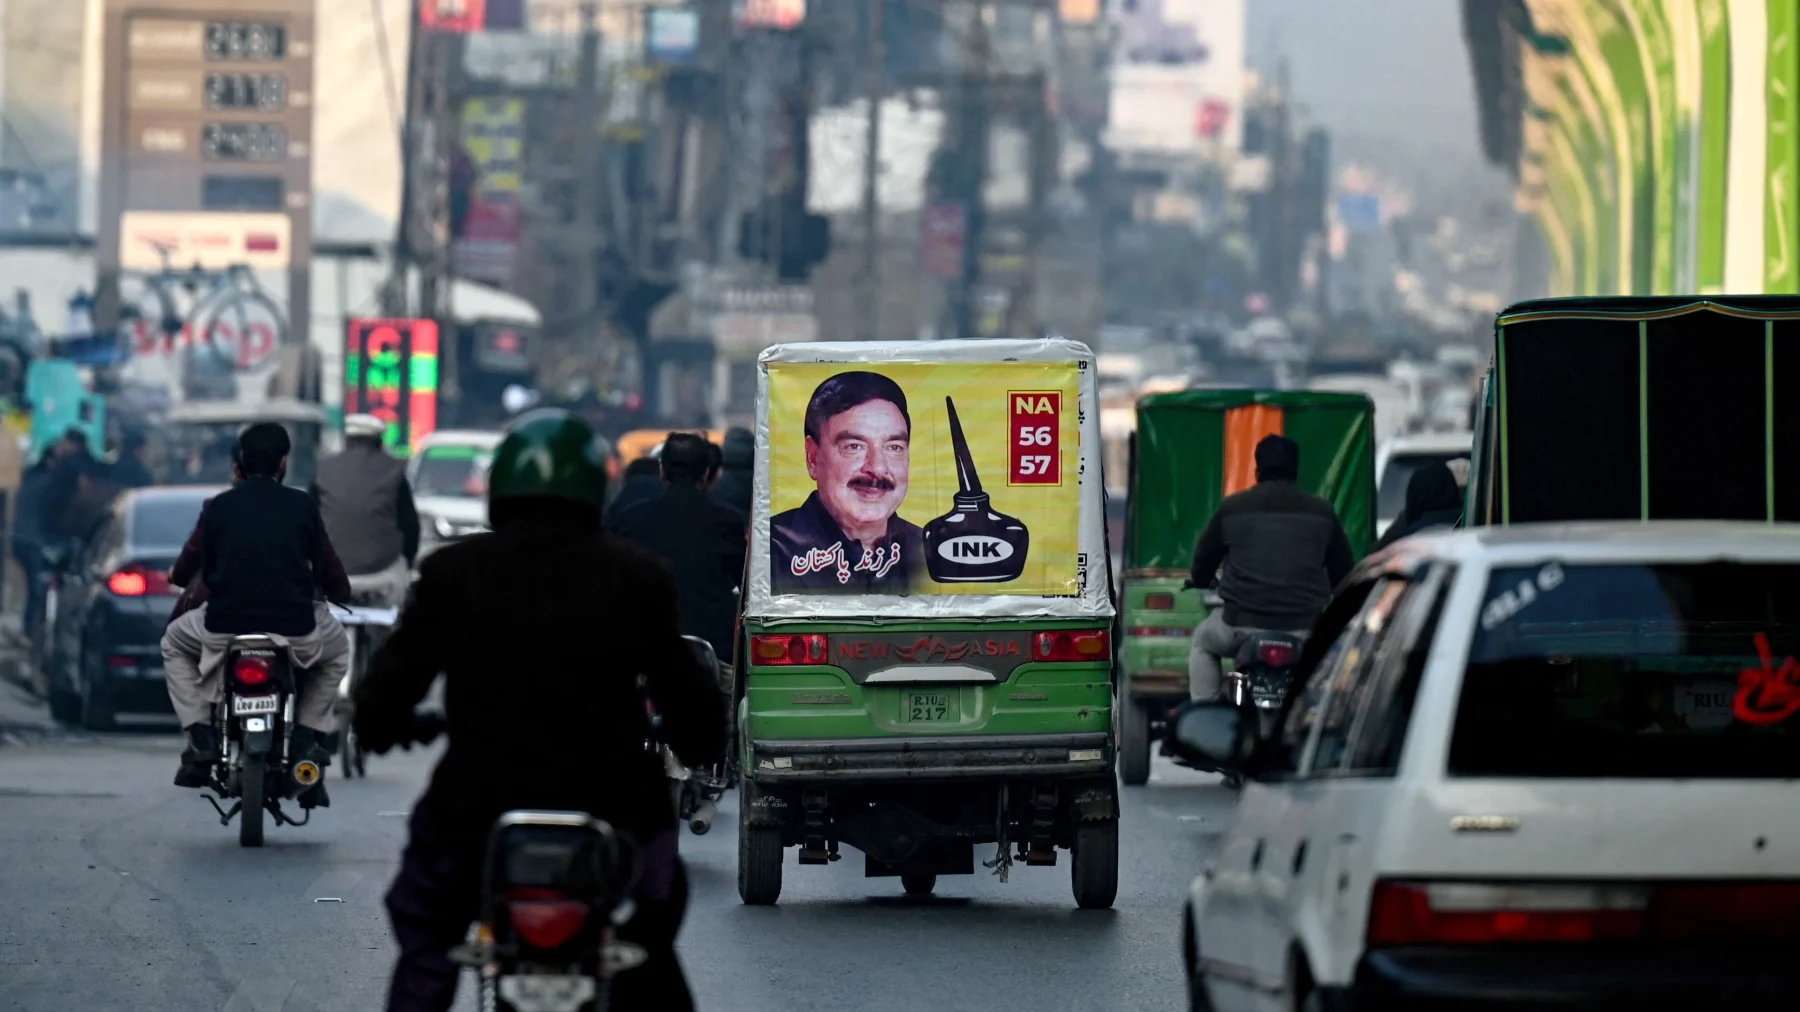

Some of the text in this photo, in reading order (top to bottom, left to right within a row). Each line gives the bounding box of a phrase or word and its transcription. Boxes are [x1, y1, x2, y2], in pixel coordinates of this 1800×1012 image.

[1016, 396, 1055, 415] NA
[1018, 426, 1052, 446] 56
[1018, 455, 1052, 475] 57
[952, 541, 1002, 558] INK
[853, 542, 901, 578] فرزند
[839, 640, 1020, 660] NEW ASIA
[914, 696, 938, 706] RIU
[912, 707, 946, 720] 217
